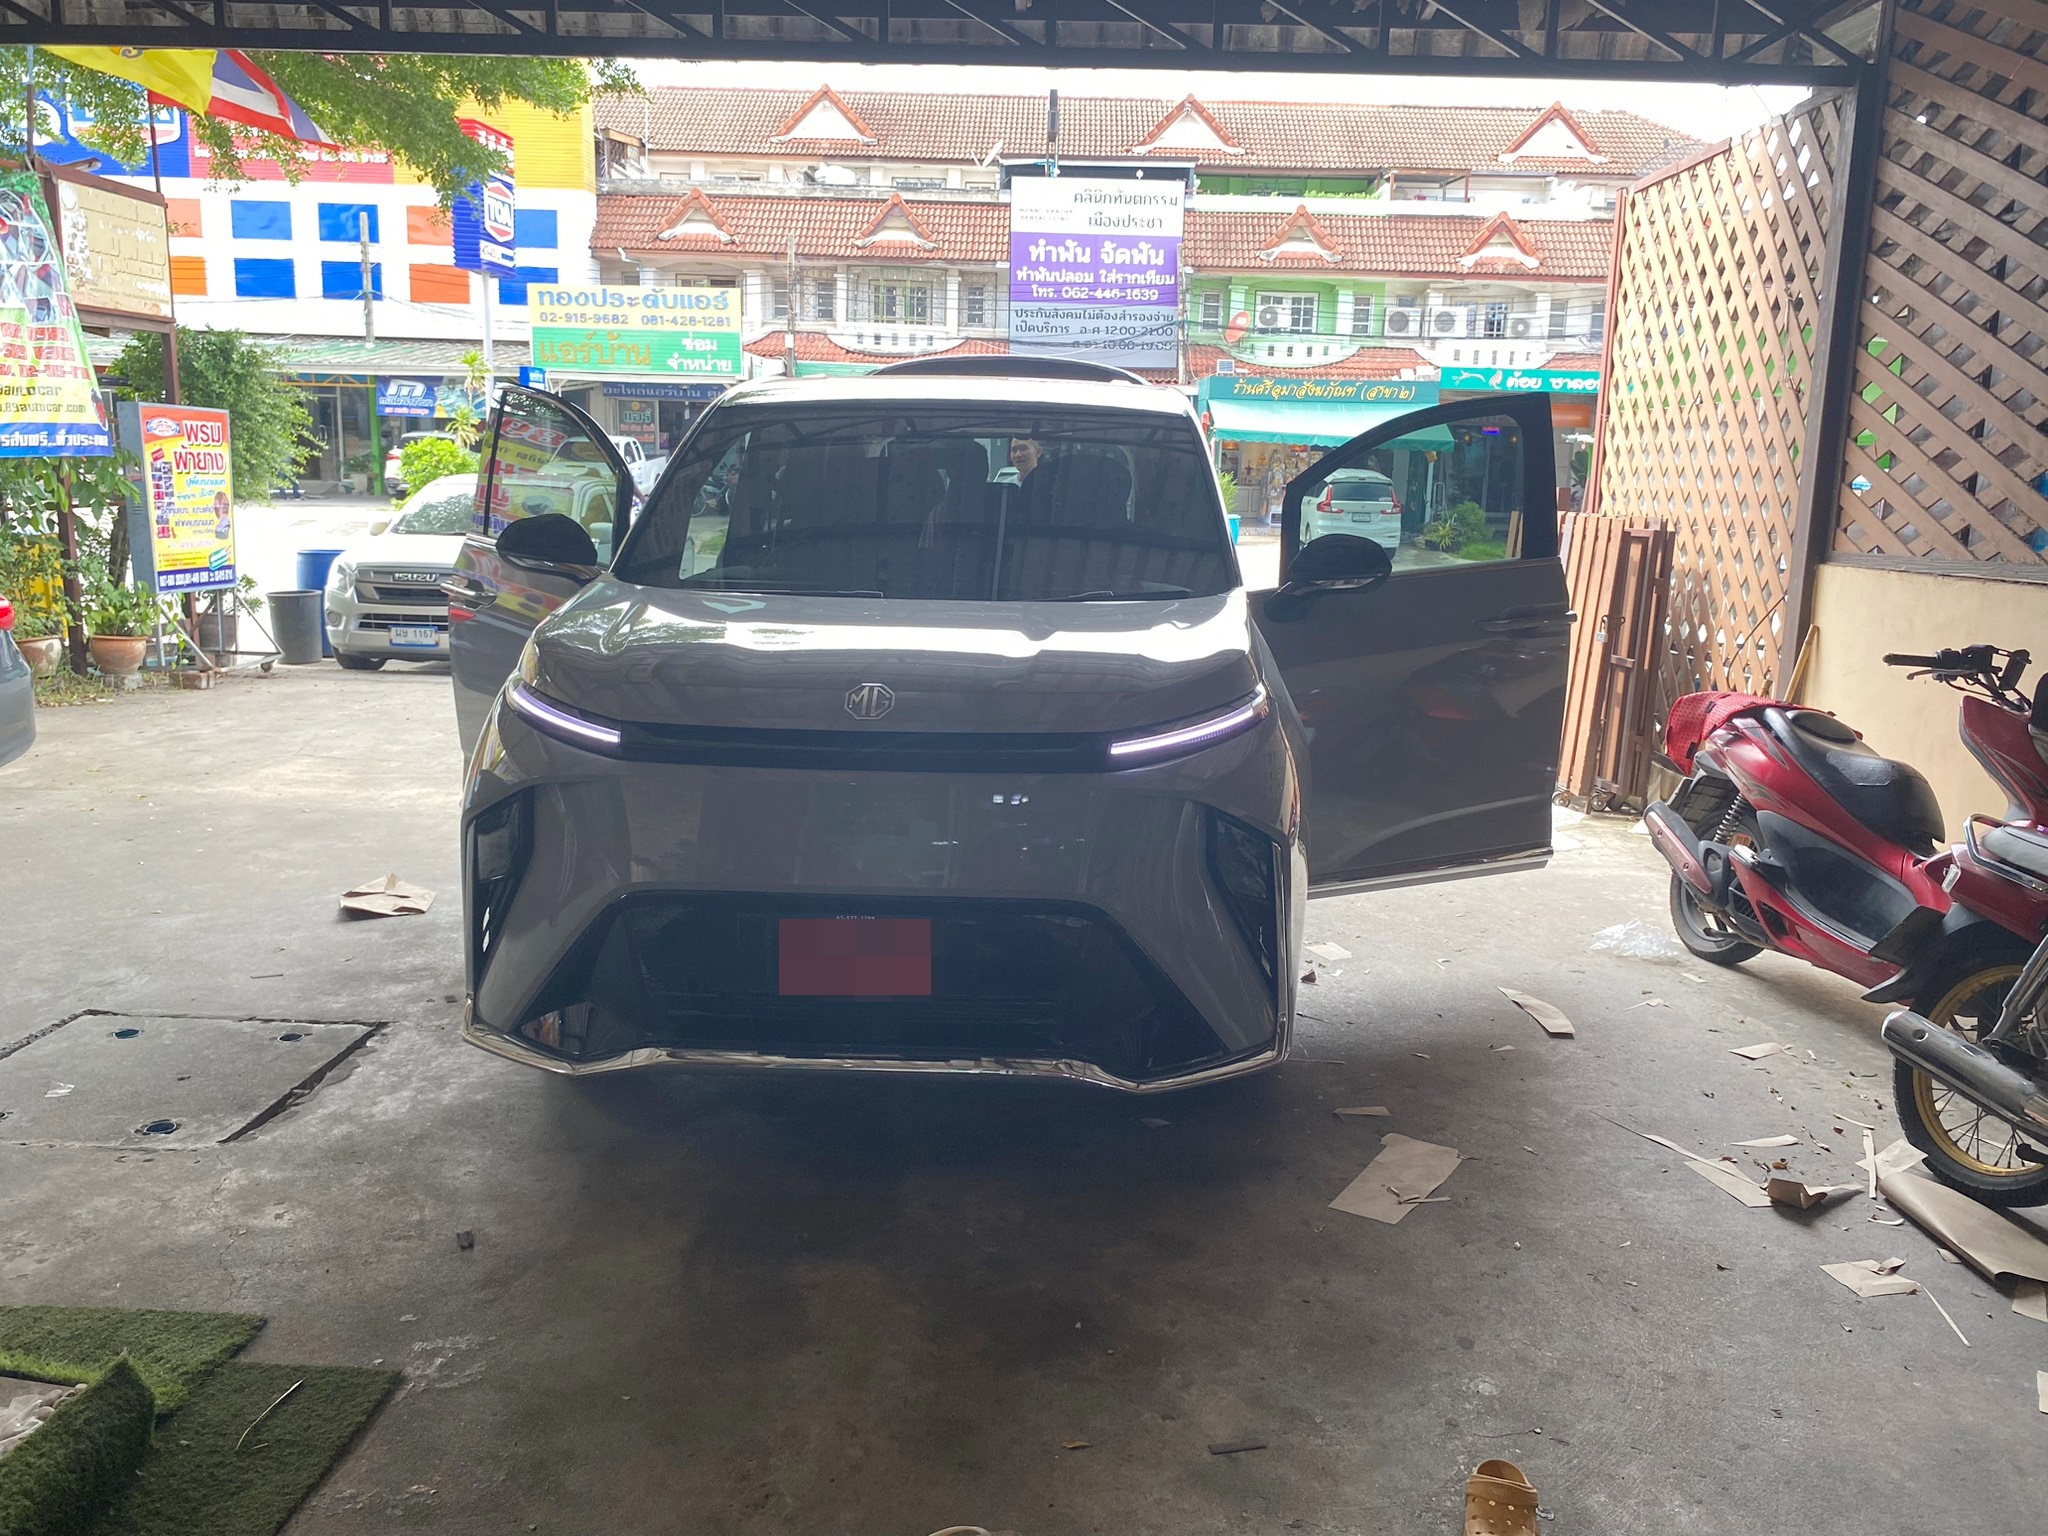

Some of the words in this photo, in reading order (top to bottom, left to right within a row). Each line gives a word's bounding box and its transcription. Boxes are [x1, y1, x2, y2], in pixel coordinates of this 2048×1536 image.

[1073, 188, 1178, 206] คลินิกทันตกรรม
[488, 199, 512, 229] TOA
[1088, 211, 1163, 229] เมืองประชา
[1029, 239, 1091, 264] ทำฟัน
[1100, 241, 1165, 266] จัดฟัน
[1016, 266, 1094, 283] ทำฟันปลอม
[1099, 269, 1175, 285] ใส่รากเทียม
[537, 288, 730, 311] ทองประดับแอร์
[1031, 285, 1057, 298] โทร.
[539, 312, 629, 325] 02-915-9682
[641, 315, 731, 327] 081-428-1281
[1015, 321, 1070, 334] เปิดบริการ
[539, 331, 651, 366] แอร์บ้าน
[681, 332, 718, 352] ซ่อม
[667, 353, 733, 372] จำหน่าย
[1506, 371, 1542, 389] ต้อย
[603, 384, 700, 397] อะไหล่แอร์บ้าน
[623, 409, 651, 423] แอร์
[185, 423, 221, 443] พรม
[174, 444, 224, 470] ผ้ายาง
[394, 573, 439, 582] ISUZU
[413, 630, 433, 639] 1167
[848, 686, 891, 717] MG
